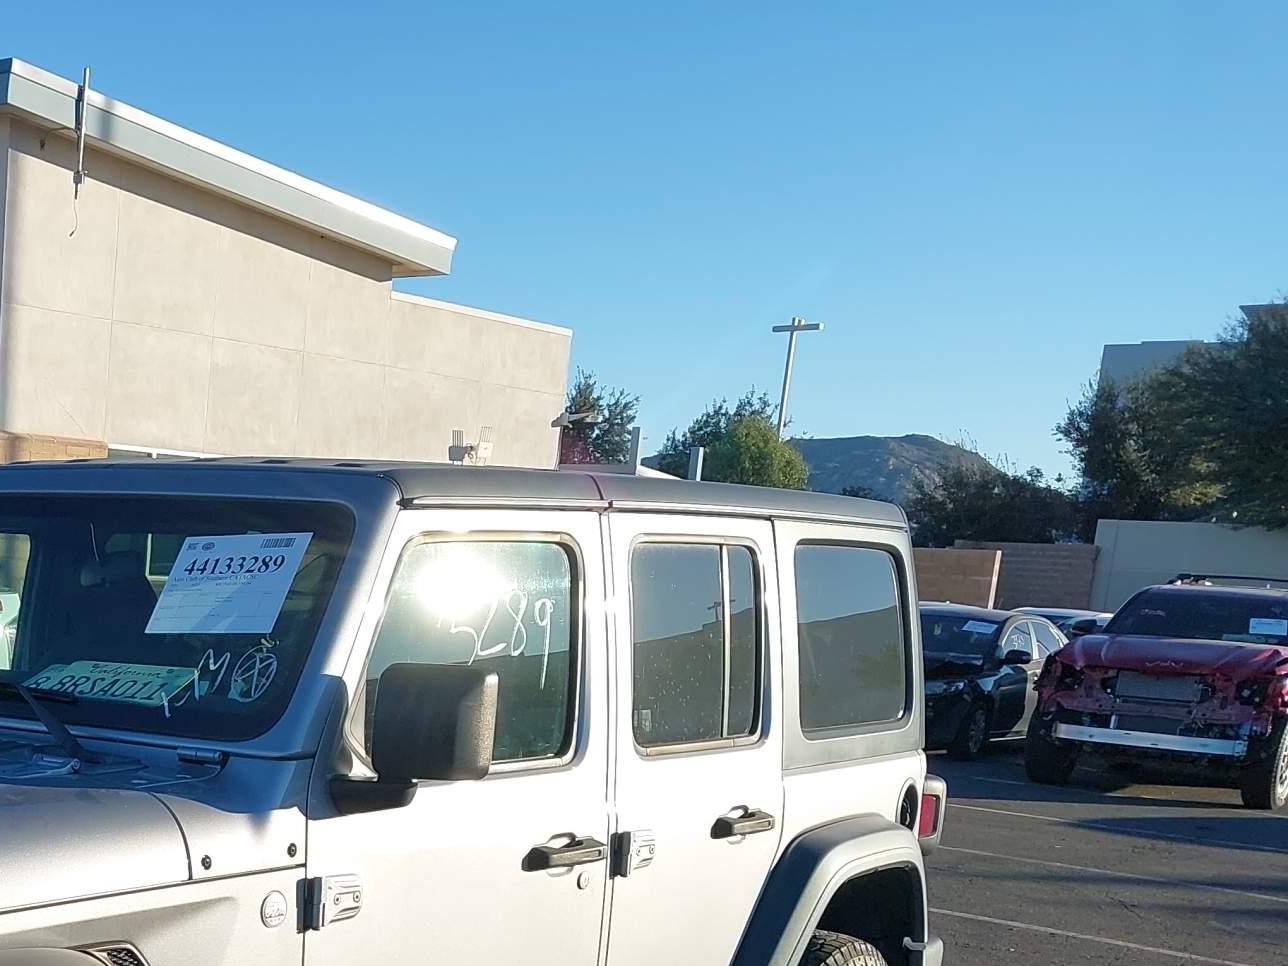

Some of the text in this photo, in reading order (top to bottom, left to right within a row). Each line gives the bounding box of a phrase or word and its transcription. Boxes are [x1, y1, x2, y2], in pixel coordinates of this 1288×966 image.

[184, 554, 286, 576] 44133289
[89, 663, 162, 679] California
[52, 675, 169, 701] 8RSA011
